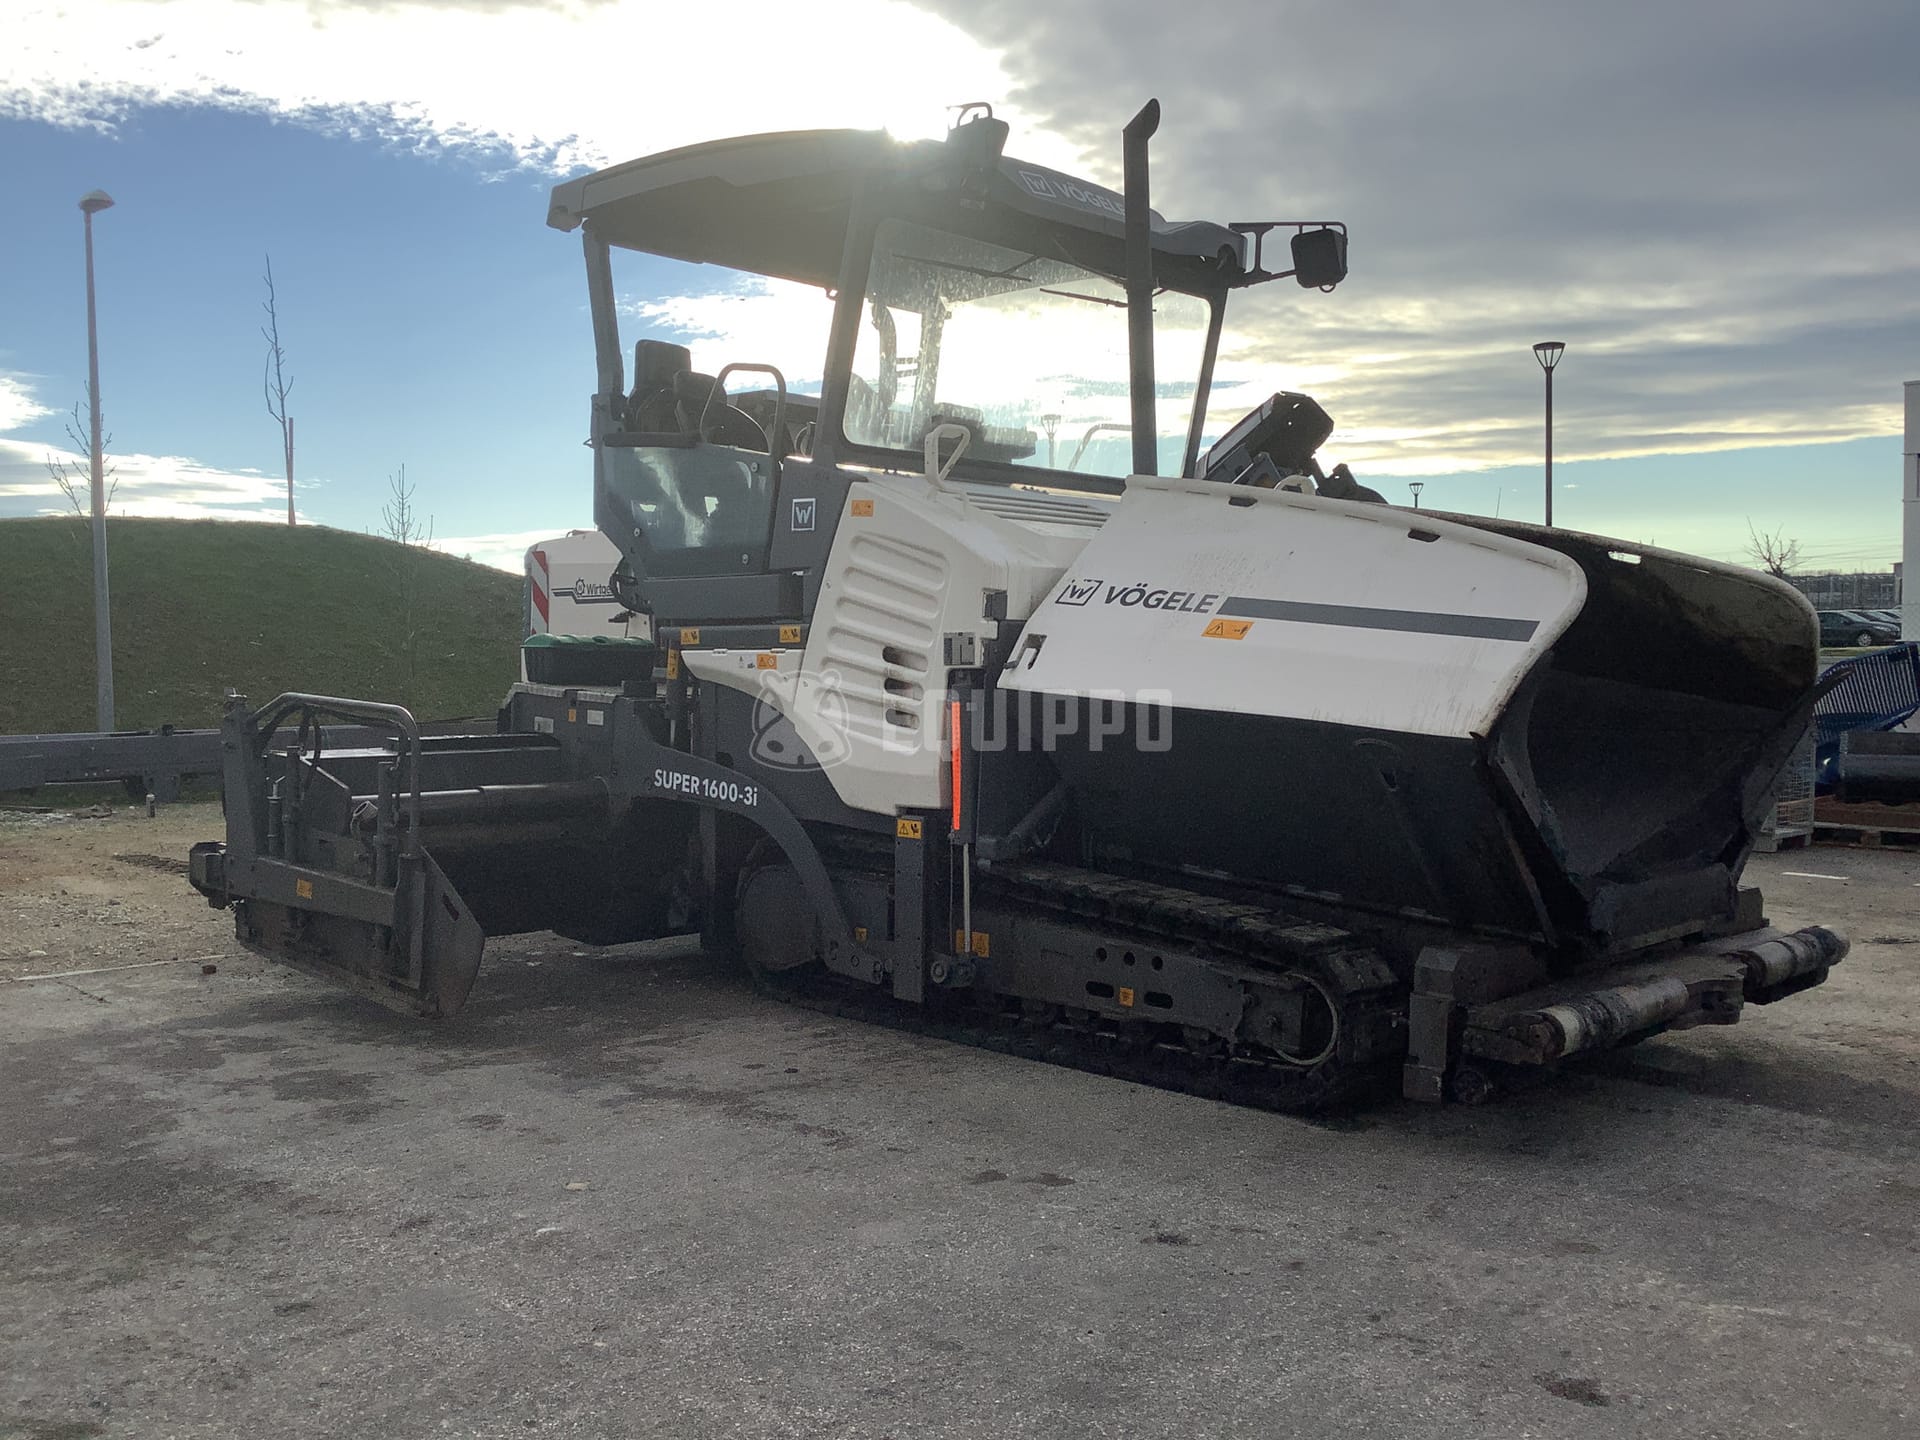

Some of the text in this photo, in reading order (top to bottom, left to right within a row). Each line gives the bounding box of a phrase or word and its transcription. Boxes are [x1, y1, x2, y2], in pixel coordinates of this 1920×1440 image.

[586, 583, 613, 595] Wirtge
[1104, 582, 1219, 614] VÖGELE
[654, 768, 758, 807] SUPER 1600-3i
